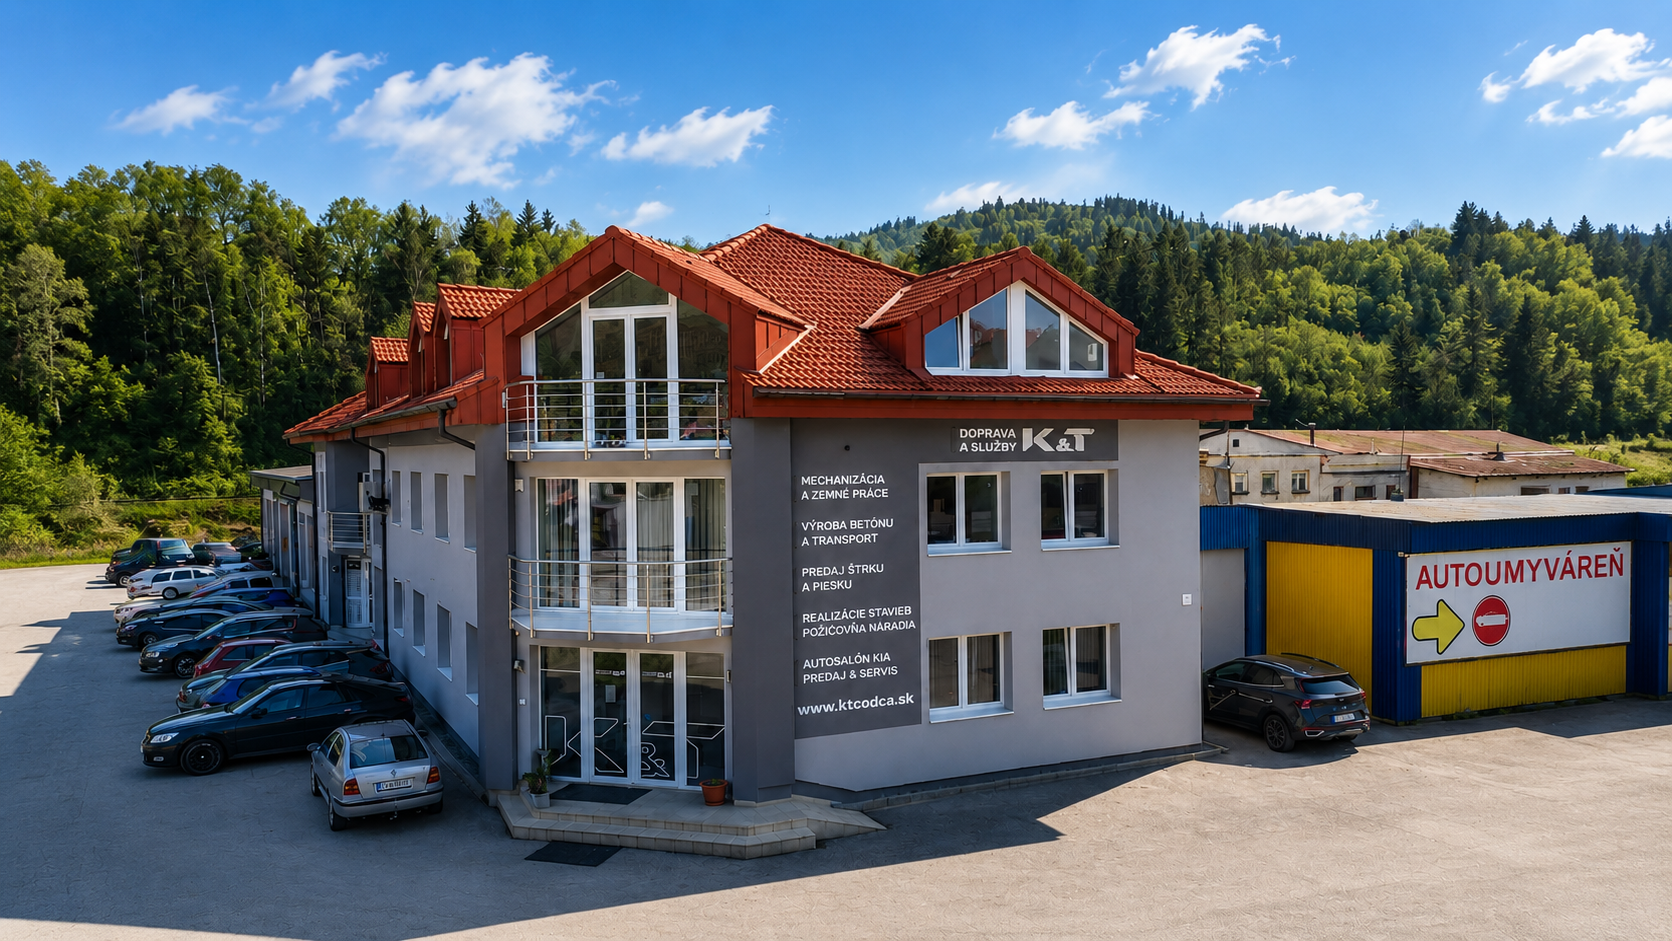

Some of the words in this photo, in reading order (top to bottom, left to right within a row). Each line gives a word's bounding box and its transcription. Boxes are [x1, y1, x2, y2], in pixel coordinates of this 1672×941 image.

[959, 428, 1017, 439] DOPRAVA
[1022, 427, 1095, 452] K&T
[959, 442, 969, 453] A
[970, 439, 1018, 452] SLUŽBY
[801, 473, 885, 486] MECHANIZÁCIA
[801, 490, 810, 501] A
[811, 487, 850, 500] ZEMNÉ
[852, 487, 889, 499] PRÁCE
[801, 519, 848, 532] VÝROBA
[849, 517, 894, 530] BETÓNU
[801, 537, 810, 547] A
[811, 533, 879, 546] TRANSPORT
[802, 566, 845, 577] PREDAJ
[847, 563, 885, 575] ŠTRKU
[1415, 547, 1624, 590] AUTOUMYVÁREŇ
[802, 582, 810, 593] A
[812, 579, 853, 592] PIESKU
[803, 608, 866, 623] REALIZÁCIE
[869, 606, 912, 617] STAVIEB
[869, 620, 916, 632] NÁRADIA
[803, 652, 870, 669] AUTOSALÓN
[872, 652, 891, 663] KIA
[803, 671, 846, 684] PREDAJ
[849, 669, 857, 679] &
[859, 665, 899, 679] SERVIS
[797, 692, 915, 716] www.ktcodca.sk
